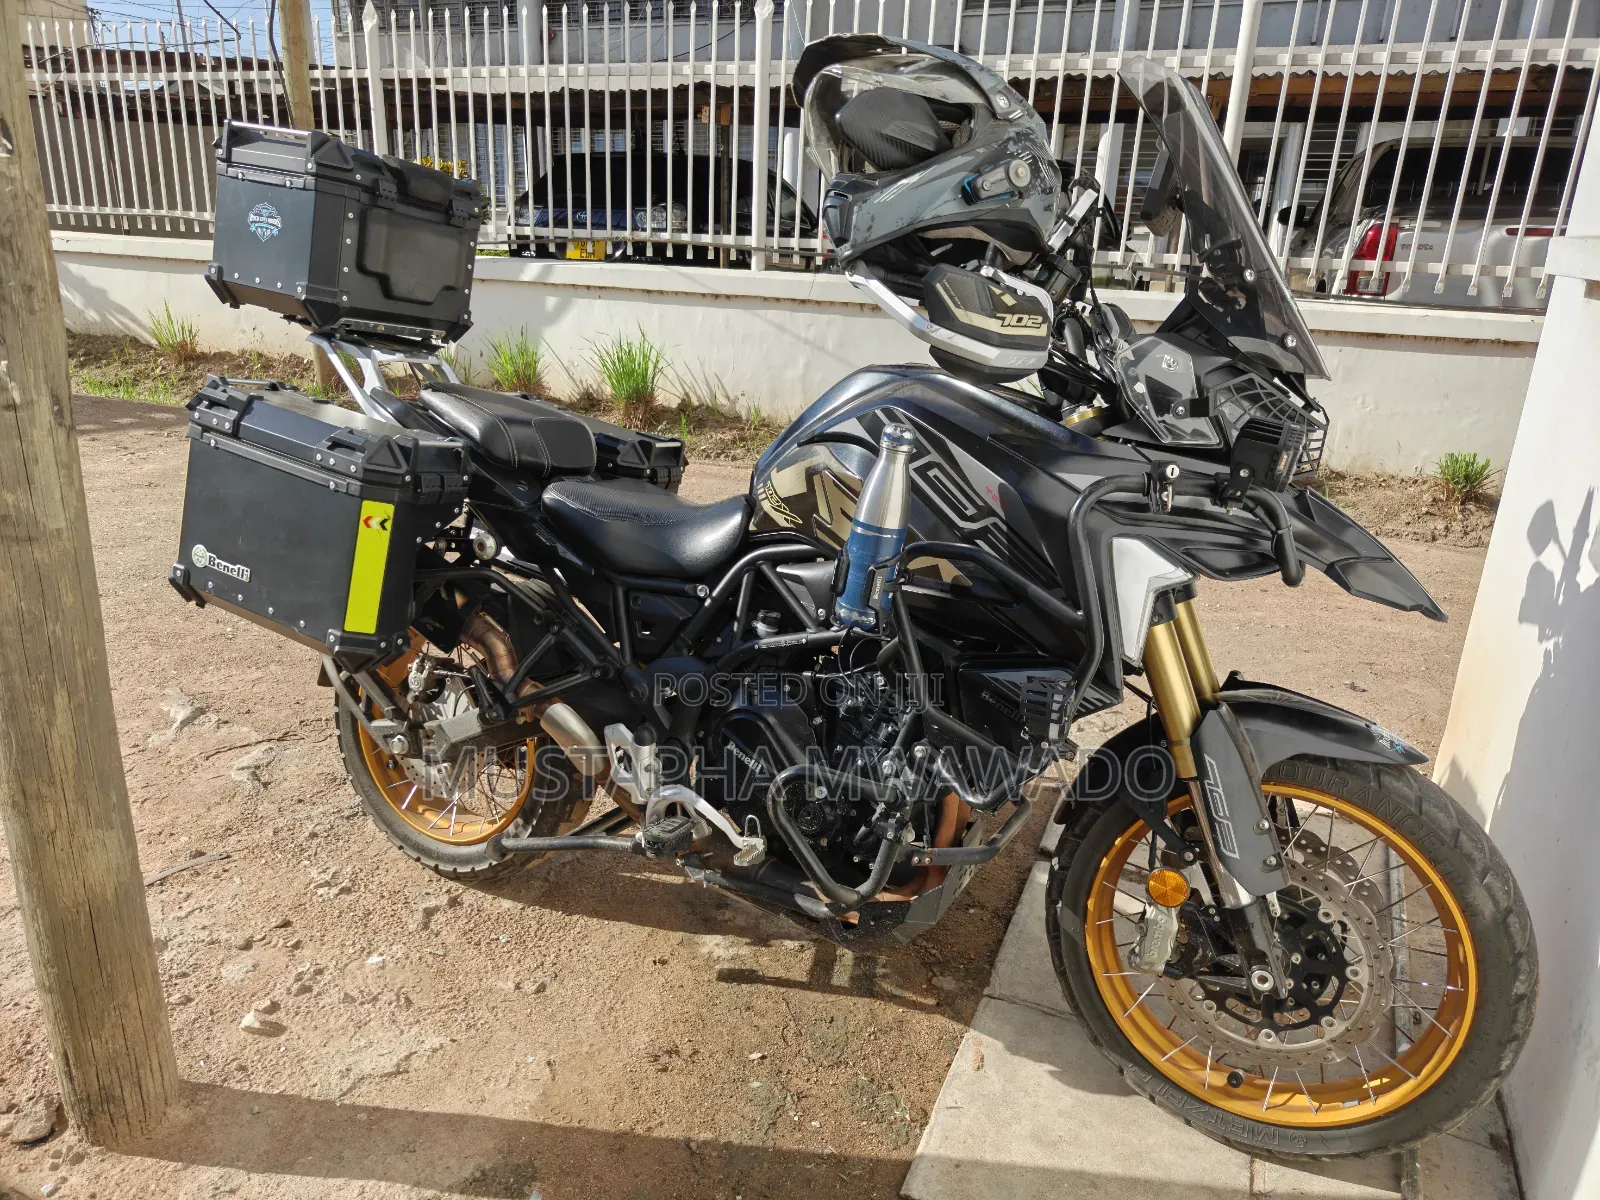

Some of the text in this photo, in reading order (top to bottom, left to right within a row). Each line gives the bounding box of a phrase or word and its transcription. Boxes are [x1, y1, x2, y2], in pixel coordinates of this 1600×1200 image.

[1400, 243, 1434, 251] TOOTA
[995, 313, 1044, 329] 702
[726, 739, 763, 773] Benelli
[1264, 758, 1447, 853] OURANCE
[1145, 915, 1167, 959] brembo
